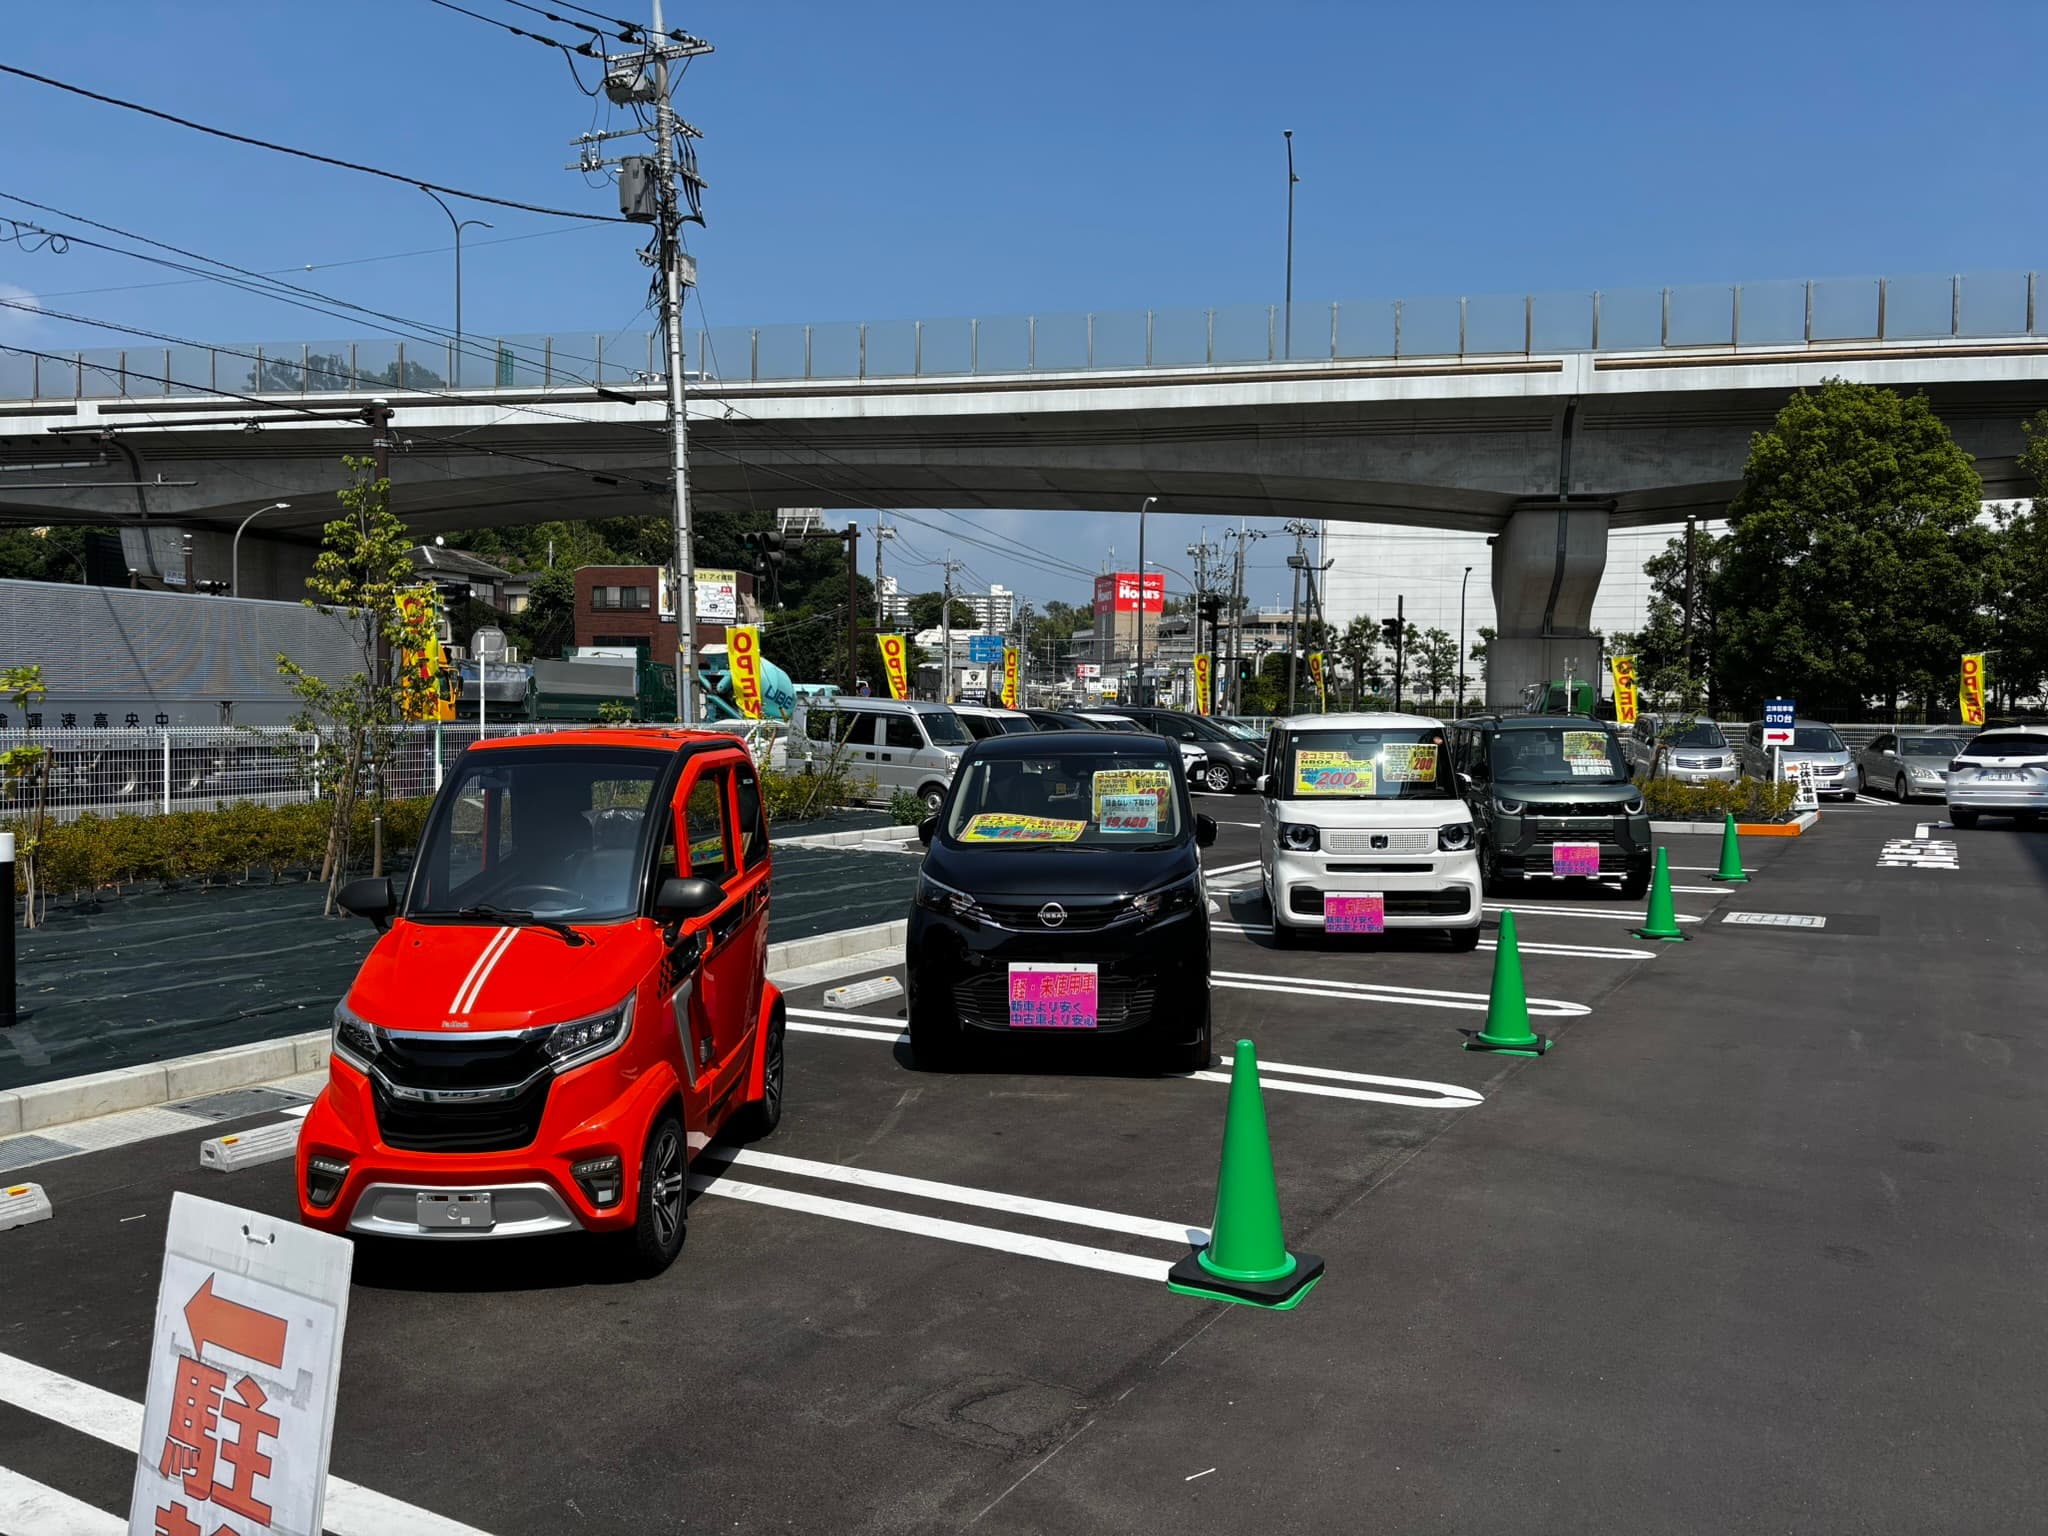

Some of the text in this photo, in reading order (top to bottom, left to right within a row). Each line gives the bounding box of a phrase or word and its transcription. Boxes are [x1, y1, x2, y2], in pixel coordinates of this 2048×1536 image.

[764, 685, 794, 710] UBE
[1766, 714, 1792, 723] 610台
[1412, 757, 1434, 771] 200
[1316, 771, 1357, 786] 200
